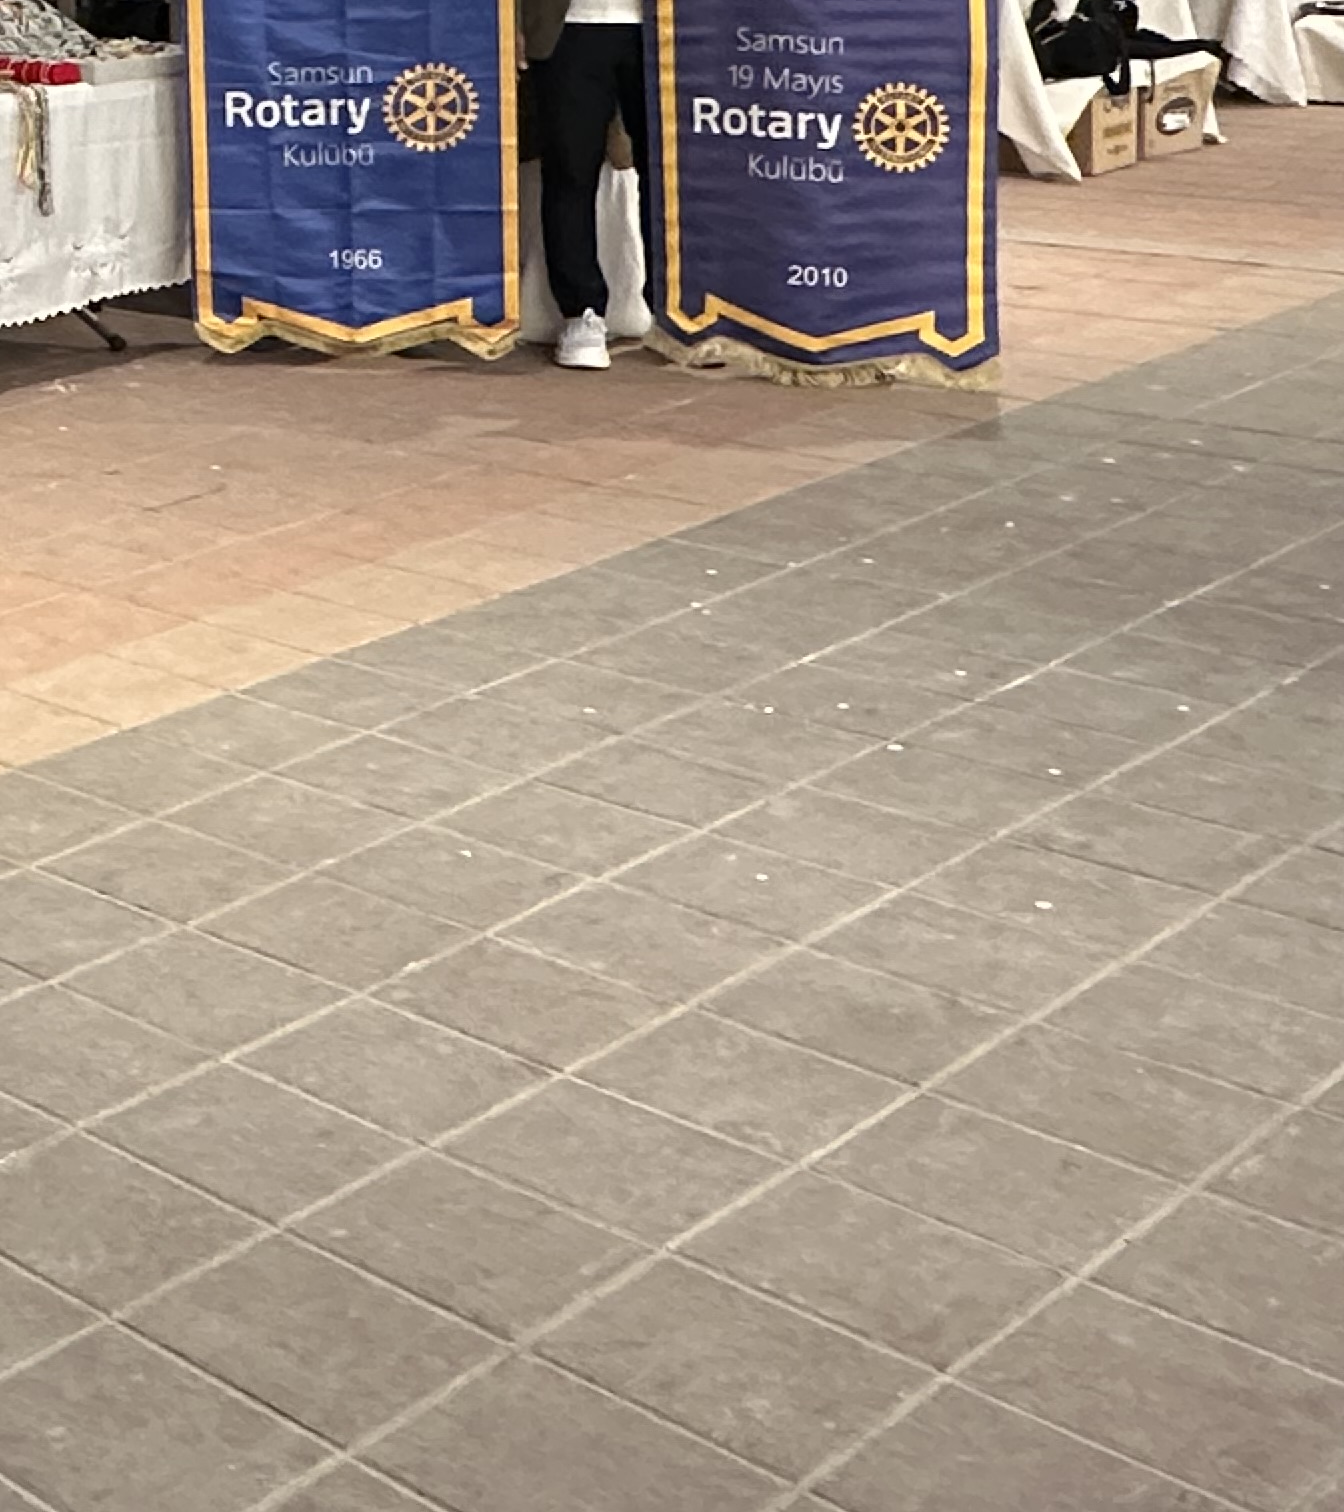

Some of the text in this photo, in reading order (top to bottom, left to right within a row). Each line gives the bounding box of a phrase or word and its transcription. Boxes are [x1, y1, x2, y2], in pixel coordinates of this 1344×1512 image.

[736, 26, 845, 56] Samsun
[266, 61, 374, 86] Samsun
[727, 64, 755, 89] 19
[763, 67, 844, 99] Mayıs
[224, 91, 372, 135] Rotary
[692, 97, 843, 150] Rotary
[282, 141, 375, 168] Kulübü
[747, 153, 845, 183] Kulübü
[328, 248, 383, 270] 1966
[786, 264, 849, 288] 2010
